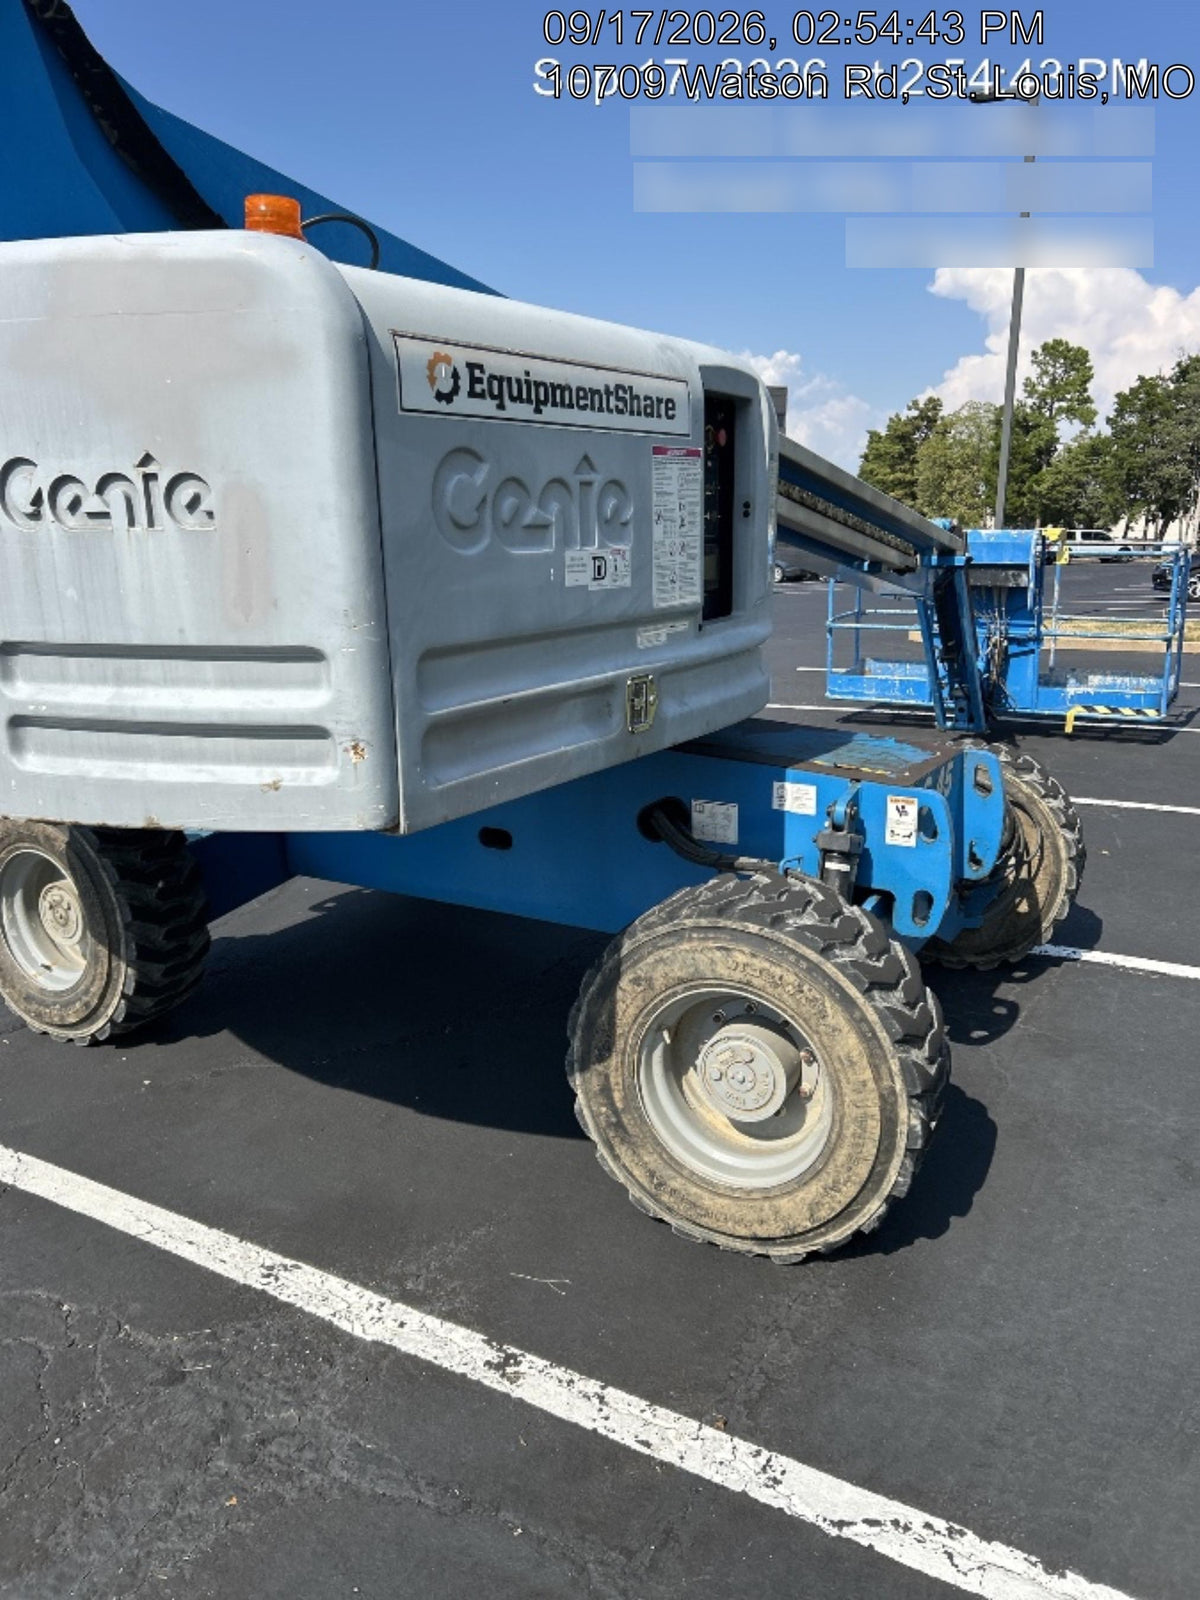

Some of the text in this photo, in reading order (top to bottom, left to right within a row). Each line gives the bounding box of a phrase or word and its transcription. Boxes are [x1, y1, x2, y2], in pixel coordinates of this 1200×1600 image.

[465, 361, 676, 421] EquipmentShare
[0, 449, 217, 533] Genie
[432, 445, 635, 556] Genie
